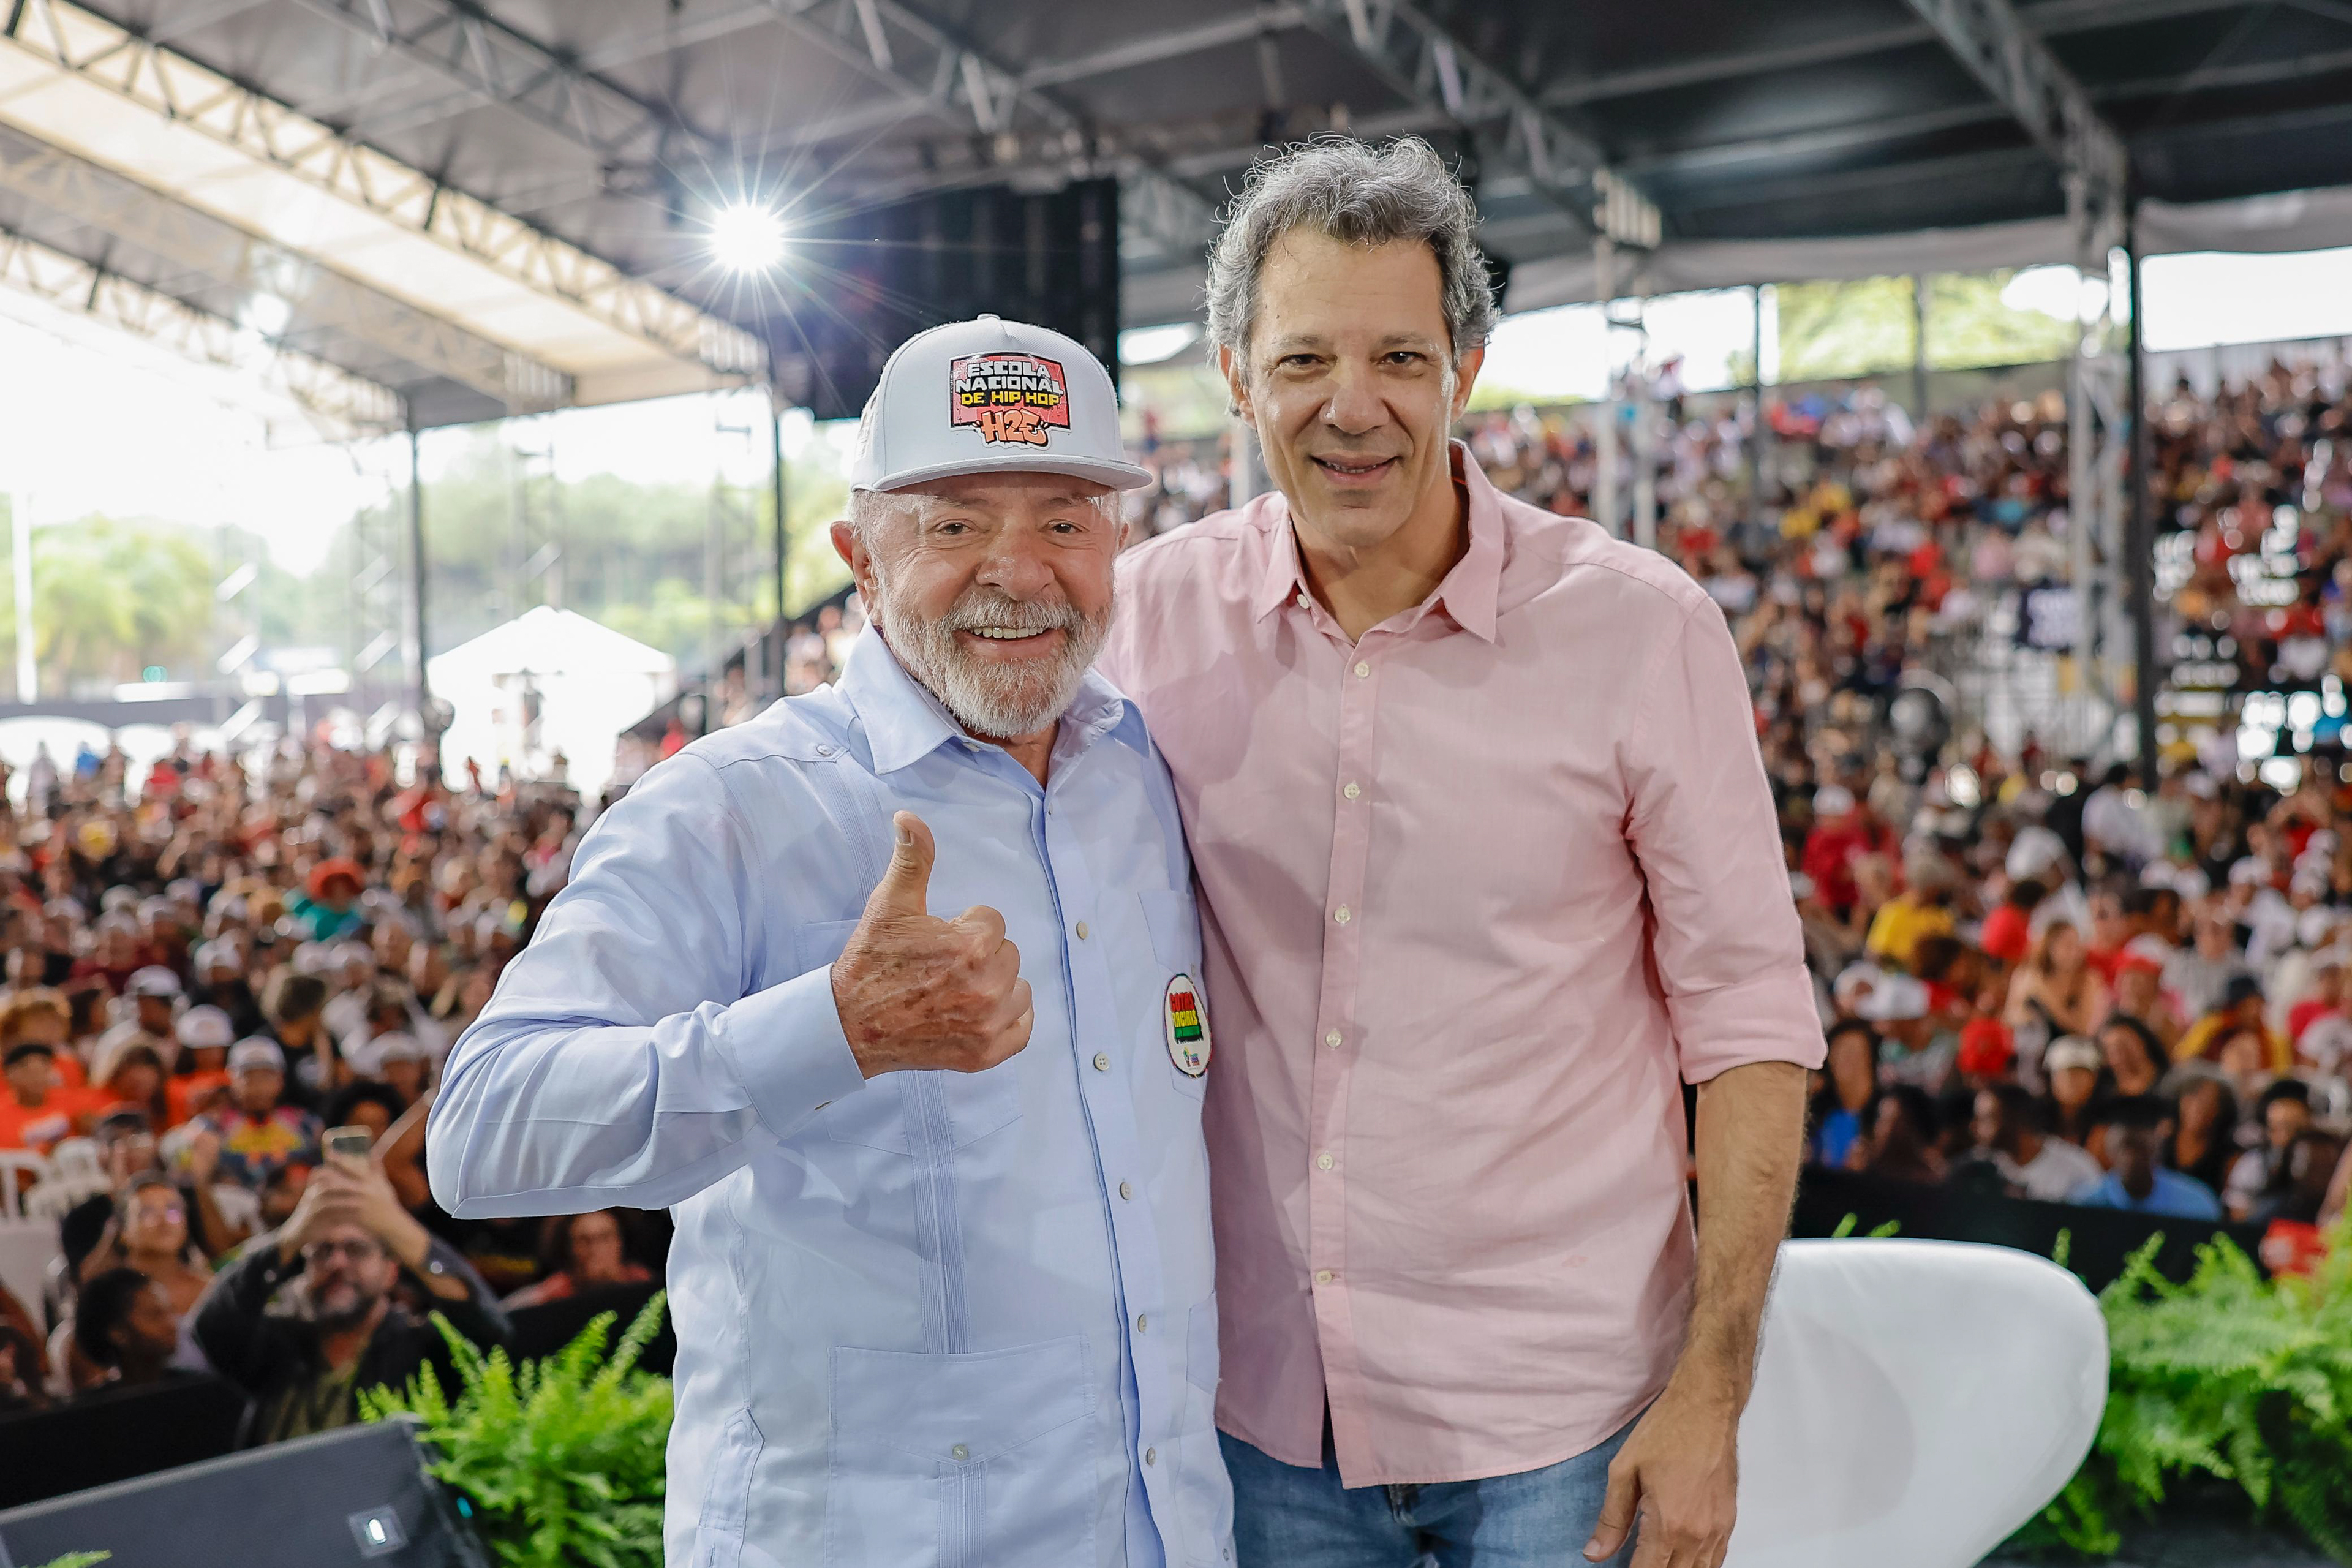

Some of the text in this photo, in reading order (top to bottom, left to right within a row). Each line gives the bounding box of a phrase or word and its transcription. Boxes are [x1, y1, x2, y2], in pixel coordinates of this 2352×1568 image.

[967, 360, 1051, 377] ESCOLA
[956, 376, 1064, 394] NACIONAL
[961, 391, 1060, 405] DE HIP HOP
[1170, 992, 1195, 1012] COTAS
[1172, 1010, 1198, 1027] RACIAIS
